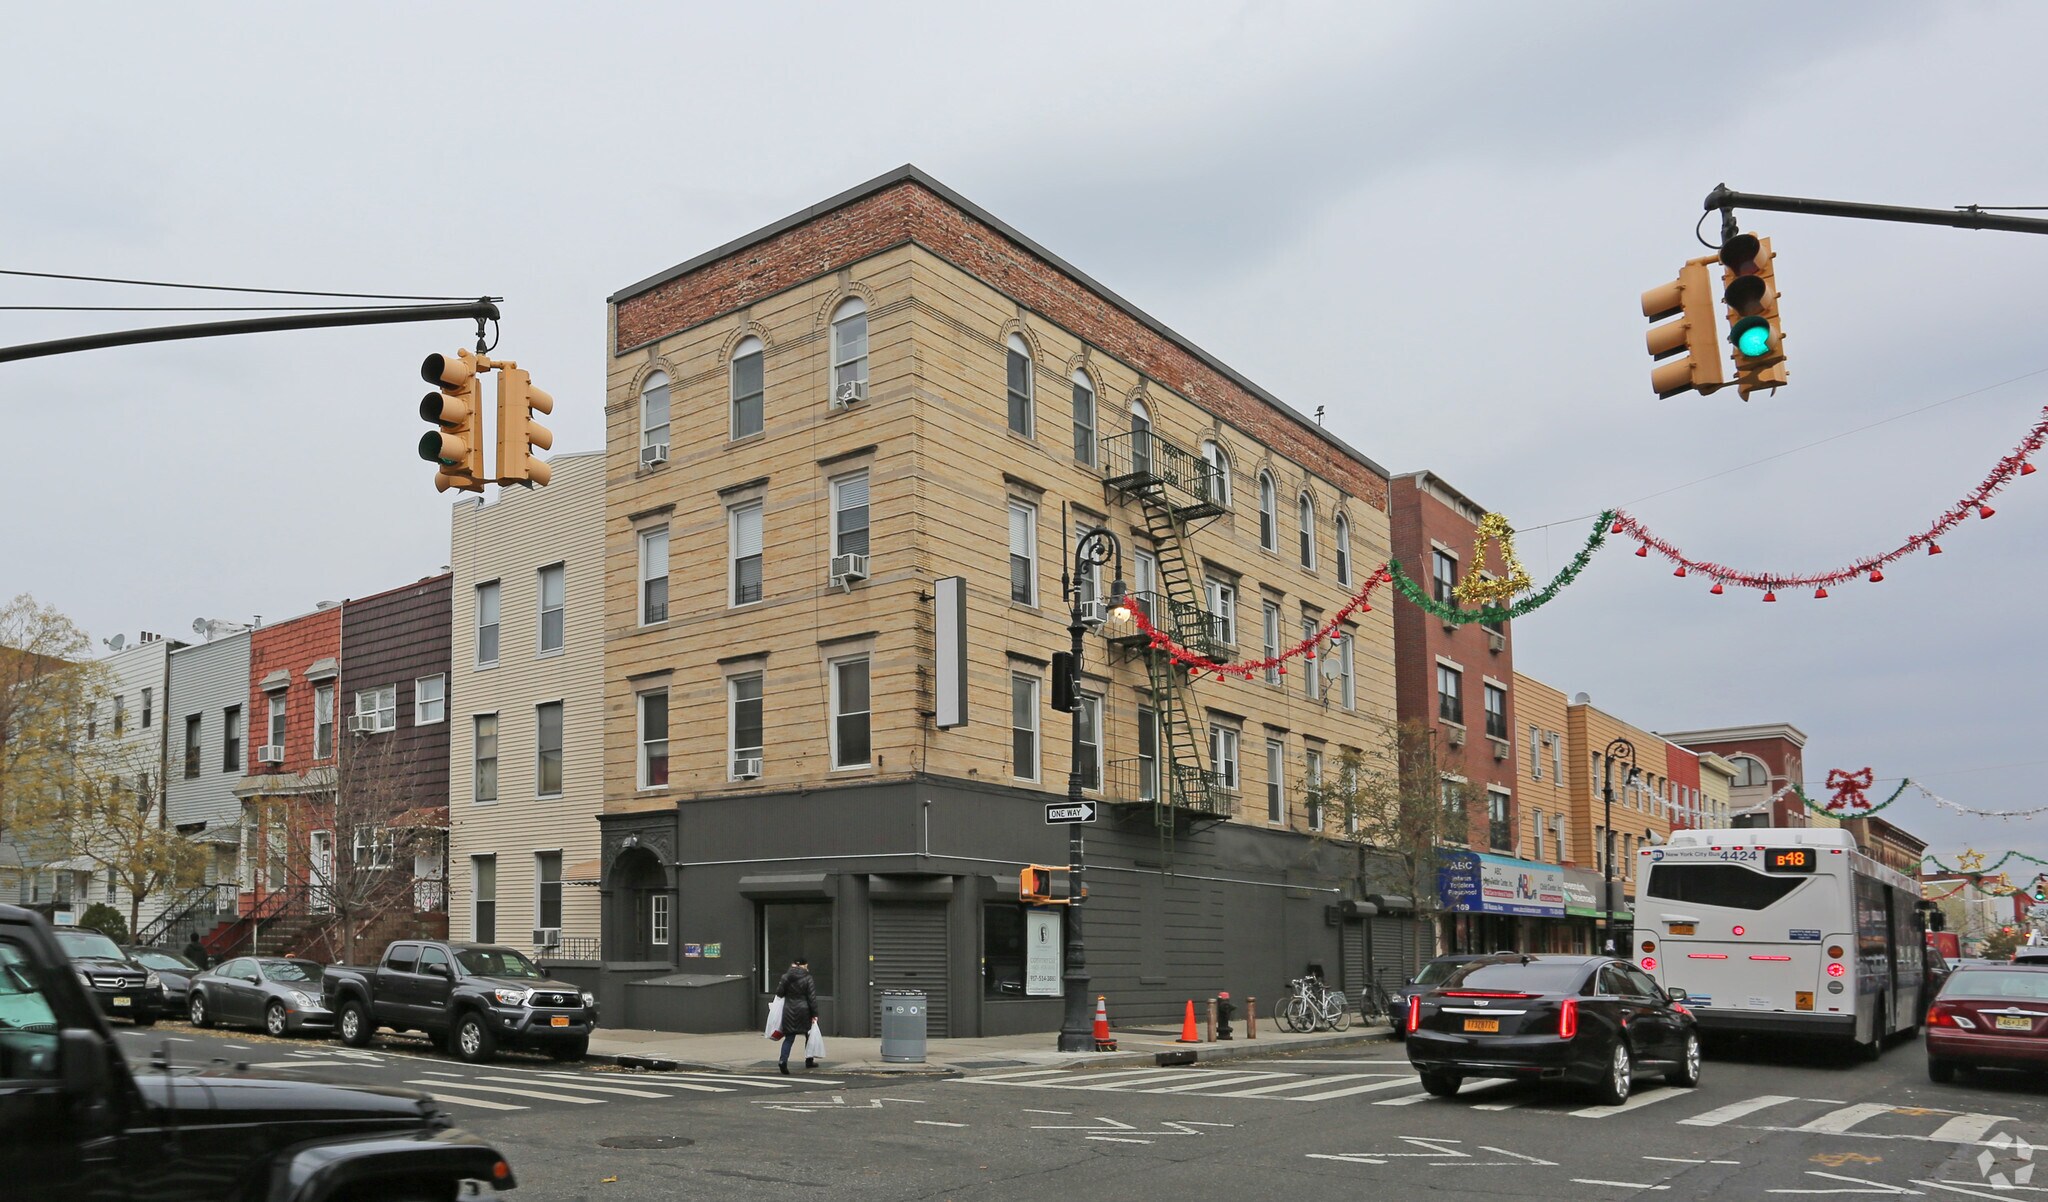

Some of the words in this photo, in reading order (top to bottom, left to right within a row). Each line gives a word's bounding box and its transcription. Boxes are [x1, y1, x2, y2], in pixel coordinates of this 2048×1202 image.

[1051, 809, 1066, 818] ONE
[1067, 808, 1082, 817] WAY
[1720, 851, 1758, 861] 4424
[1776, 851, 1805, 866] B48
[1450, 861, 1473, 870] ABC
